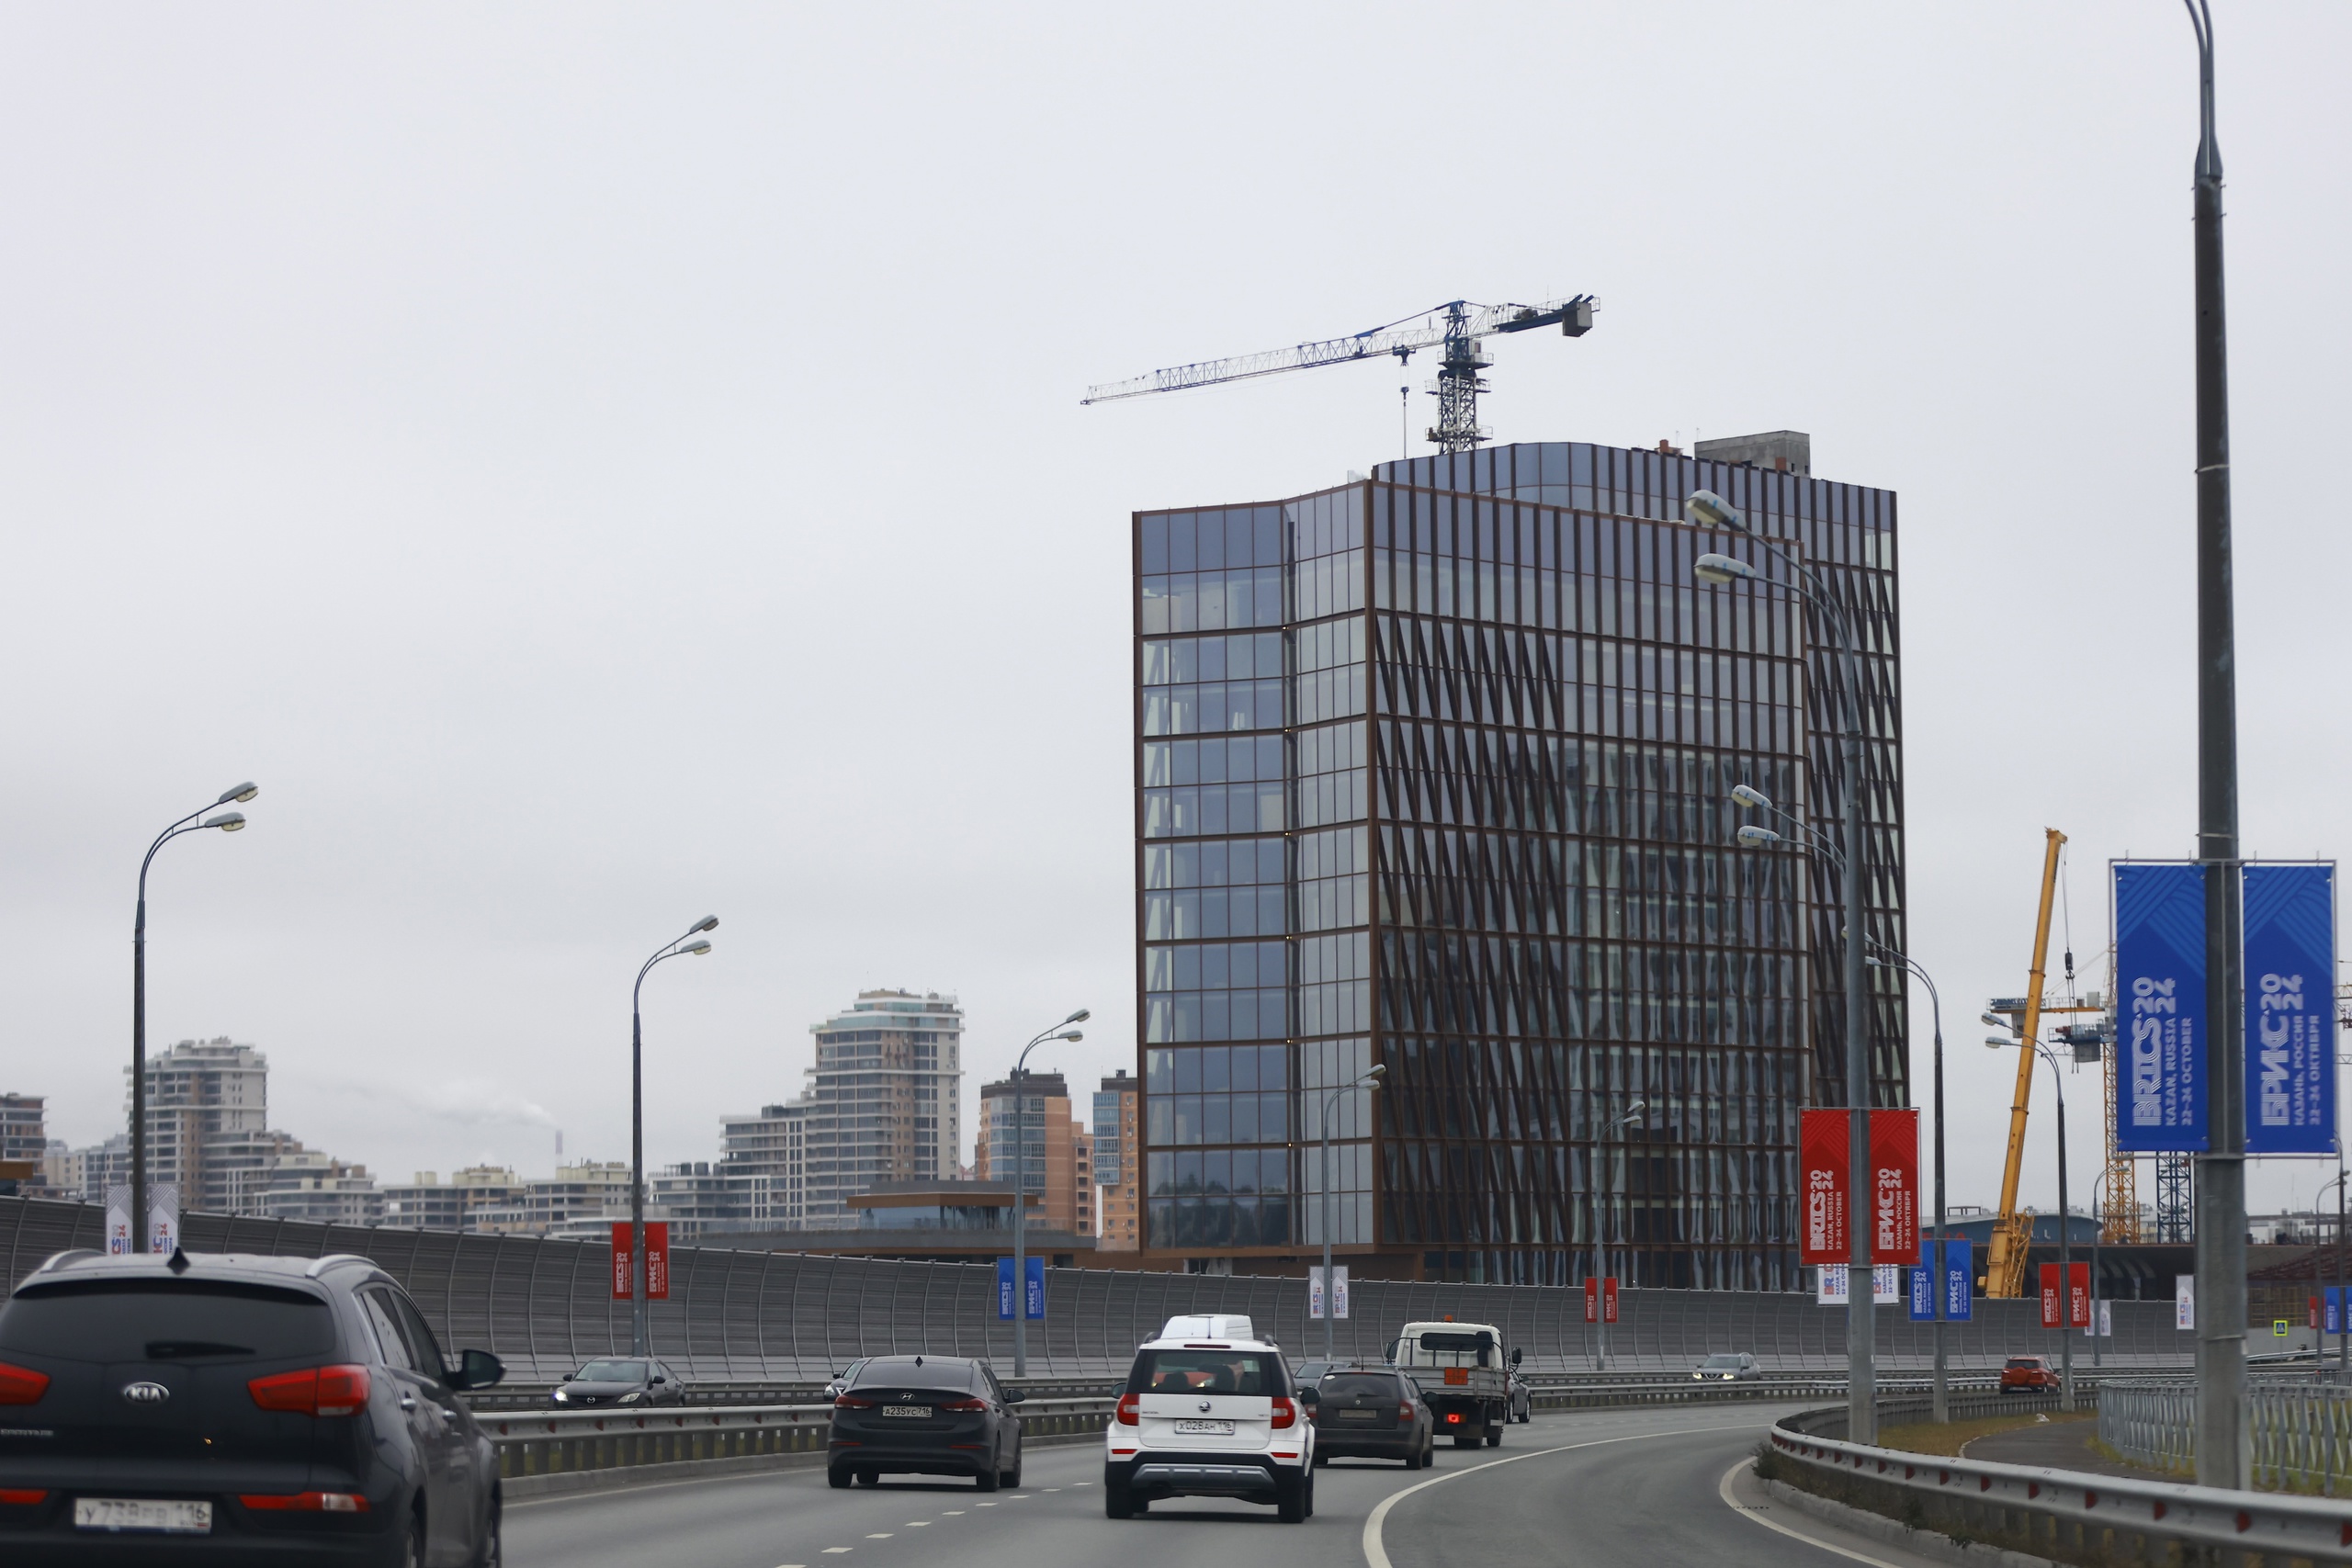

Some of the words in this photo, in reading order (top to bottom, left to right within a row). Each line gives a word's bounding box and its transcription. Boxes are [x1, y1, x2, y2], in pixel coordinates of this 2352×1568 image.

[2154, 977, 2177, 1013] 24
[2282, 974, 2303, 1010] 24
[2165, 1017, 2177, 1071] RUSSIA
[2181, 1017, 2193, 1084] OCTOBER
[2293, 1015, 2304, 1068] РОССИЯ
[2309, 1015, 2321, 1082] ОКТЯБРЯ
[2132, 1017, 2162, 1126] BRICS
[2259, 1015, 2290, 1125] БРИКС
[2165, 1073, 2177, 1126] KAZAN,
[2293, 1071, 2305, 1125] КАЗАНЬ,
[1822, 1169, 1834, 1190] 24
[1891, 1168, 1902, 1189] 24
[1810, 1191, 1826, 1250] BRICS
[1878, 1190, 1894, 1249] БРИКС
[130, 1387, 161, 1401] KIA
[885, 1406, 916, 1416] А235УС
